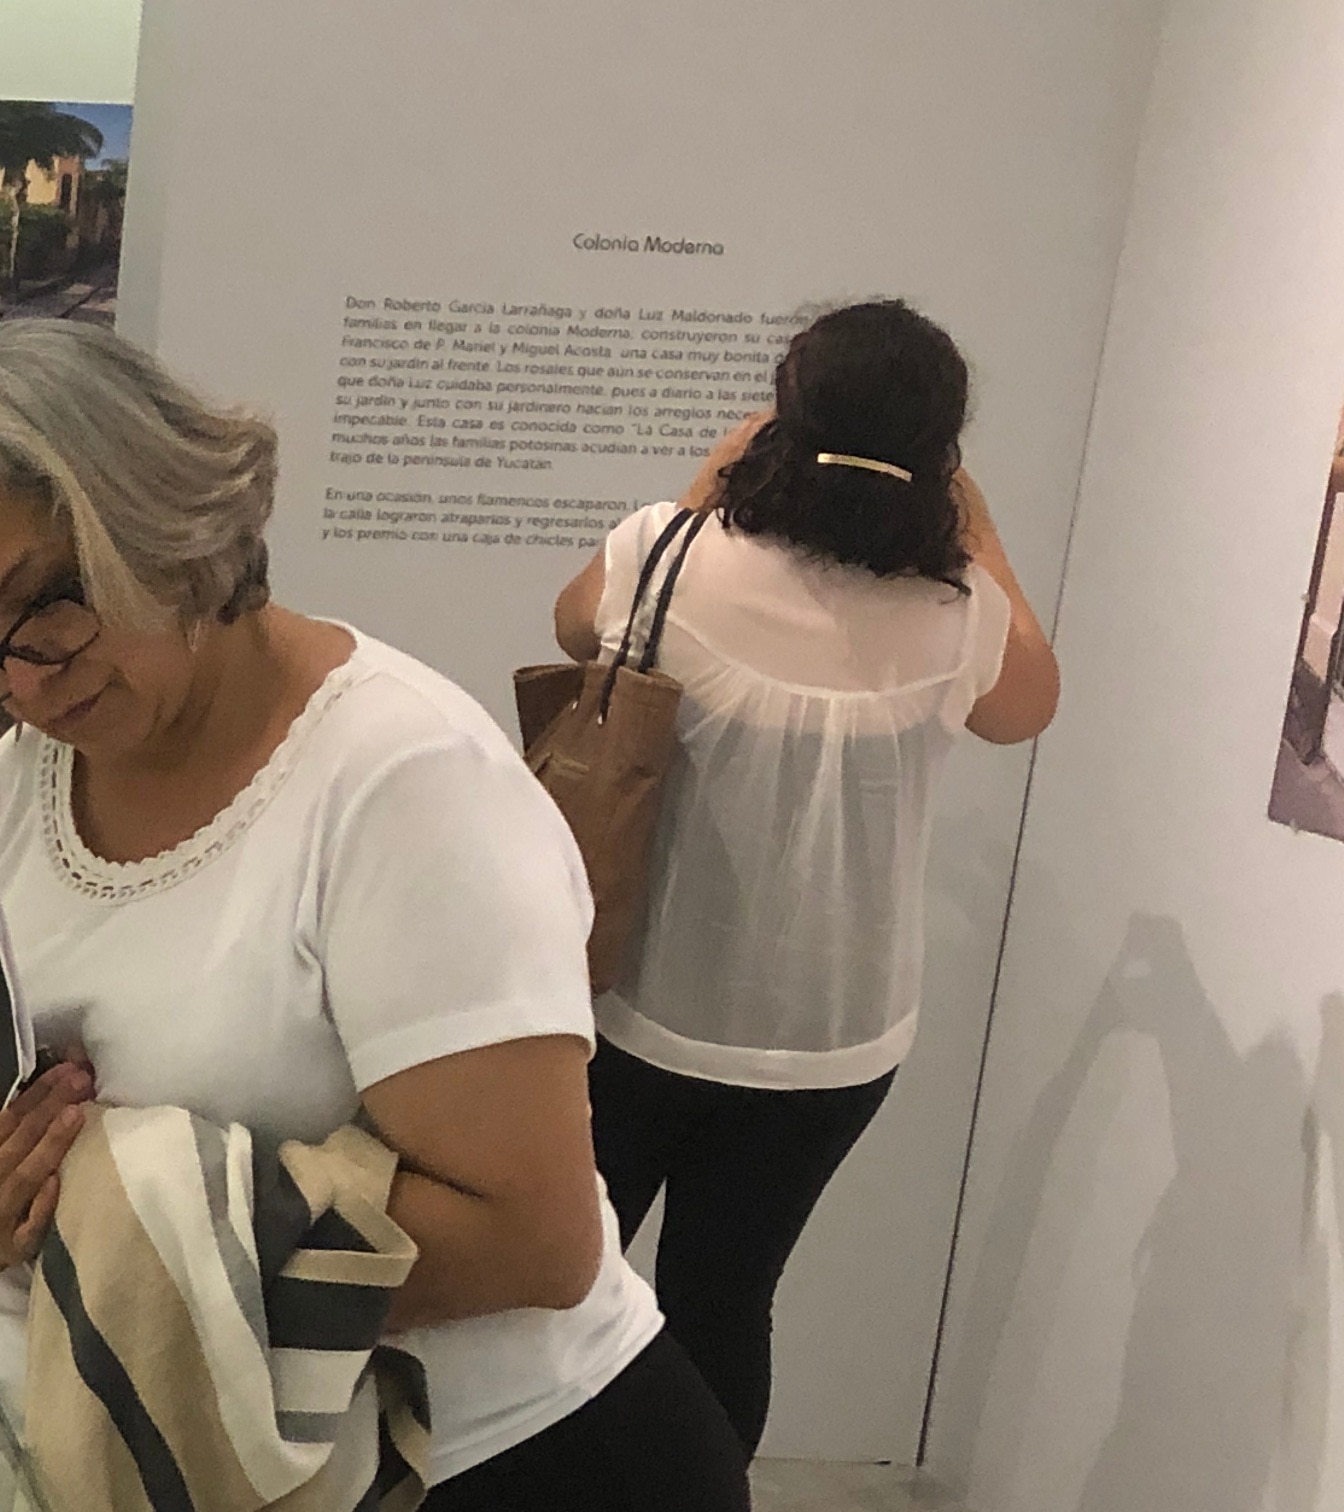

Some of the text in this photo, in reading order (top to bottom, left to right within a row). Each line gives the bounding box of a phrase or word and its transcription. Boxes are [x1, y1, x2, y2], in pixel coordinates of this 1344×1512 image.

[573, 233, 724, 255] Colonia Moderna
[346, 296, 376, 310] Don
[384, 297, 441, 312] Roberto
[502, 302, 572, 319] Larrañaga
[579, 308, 587, 320] y
[594, 307, 630, 320] doña
[639, 309, 663, 321] Luz
[671, 310, 753, 324] Maldonado
[344, 316, 397, 330] familias
[404, 321, 421, 331] en
[429, 319, 468, 334] llegar
[474, 324, 482, 334] a
[489, 321, 500, 335] la
[507, 323, 560, 335] colonia
[641, 329, 738, 344] construyeron
[744, 334, 760, 343] su
[342, 335, 409, 350] Francisco
[414, 338, 431, 350] de
[501, 345, 507, 355] y
[513, 342, 560, 358] Miguel
[620, 350, 647, 359] una
[652, 350, 683, 361] casa
[688, 352, 719, 364] muy
[723, 351, 769, 364] bonita
[339, 357, 366, 367] con
[369, 358, 386, 368] su
[431, 359, 444, 370] al
[497, 361, 520, 373] Los
[524, 362, 574, 376] rosales
[578, 366, 603, 378] que
[637, 368, 652, 378] se
[655, 368, 730, 382] conservan
[733, 372, 751, 382] en
[754, 371, 767, 383] el
[337, 376, 363, 389] que
[368, 375, 404, 388] doña
[409, 377, 432, 389] Luz
[437, 378, 492, 392] cuidaba
[612, 384, 645, 398] pues
[649, 388, 657, 398] a
[661, 387, 701, 400] diario
[706, 392, 714, 400] a
[718, 389, 736, 400] las
[336, 394, 351, 406] su
[400, 397, 407, 409] y
[413, 397, 450, 410] junto
[455, 398, 482, 410] con
[488, 399, 505, 411] su
[507, 399, 571, 414] jardinero
[628, 404, 648, 417] los
[654, 407, 711, 420] arreglos
[418, 414, 446, 428] Esta
[452, 418, 483, 429] casa
[489, 420, 504, 430] es
[511, 419, 576, 433] conocida
[583, 423, 624, 435] como
[659, 424, 692, 437] Casa
[699, 426, 717, 438] de
[332, 433, 388, 444] muchos
[393, 434, 425, 446] años
[430, 435, 448, 447] las
[452, 435, 506, 449] familias
[510, 439, 578, 453] potosinas
[641, 446, 648, 455] a
[652, 445, 673, 455] ver
[677, 448, 685, 456] a
[689, 445, 710, 457] los
[330, 451, 362, 463] trajo
[366, 453, 383, 464] de
[387, 453, 399, 464] la
[475, 456, 491, 467] de
[326, 488, 342, 500] En
[347, 490, 373, 501] una
[439, 495, 473, 505] unos
[478, 493, 549, 508] flamencos
[323, 508, 335, 519] la
[340, 509, 372, 520] calle
[377, 509, 437, 524] lograron
[441, 513, 511, 525] atraparlos
[515, 517, 522, 527] y
[527, 516, 604, 529] regresarlos
[322, 529, 330, 539] y
[333, 527, 353, 538] los
[412, 531, 438, 541] con
[443, 532, 468, 542] una
[472, 534, 500, 545] caja
[504, 533, 522, 545] de
[525, 534, 573, 547] chicles
